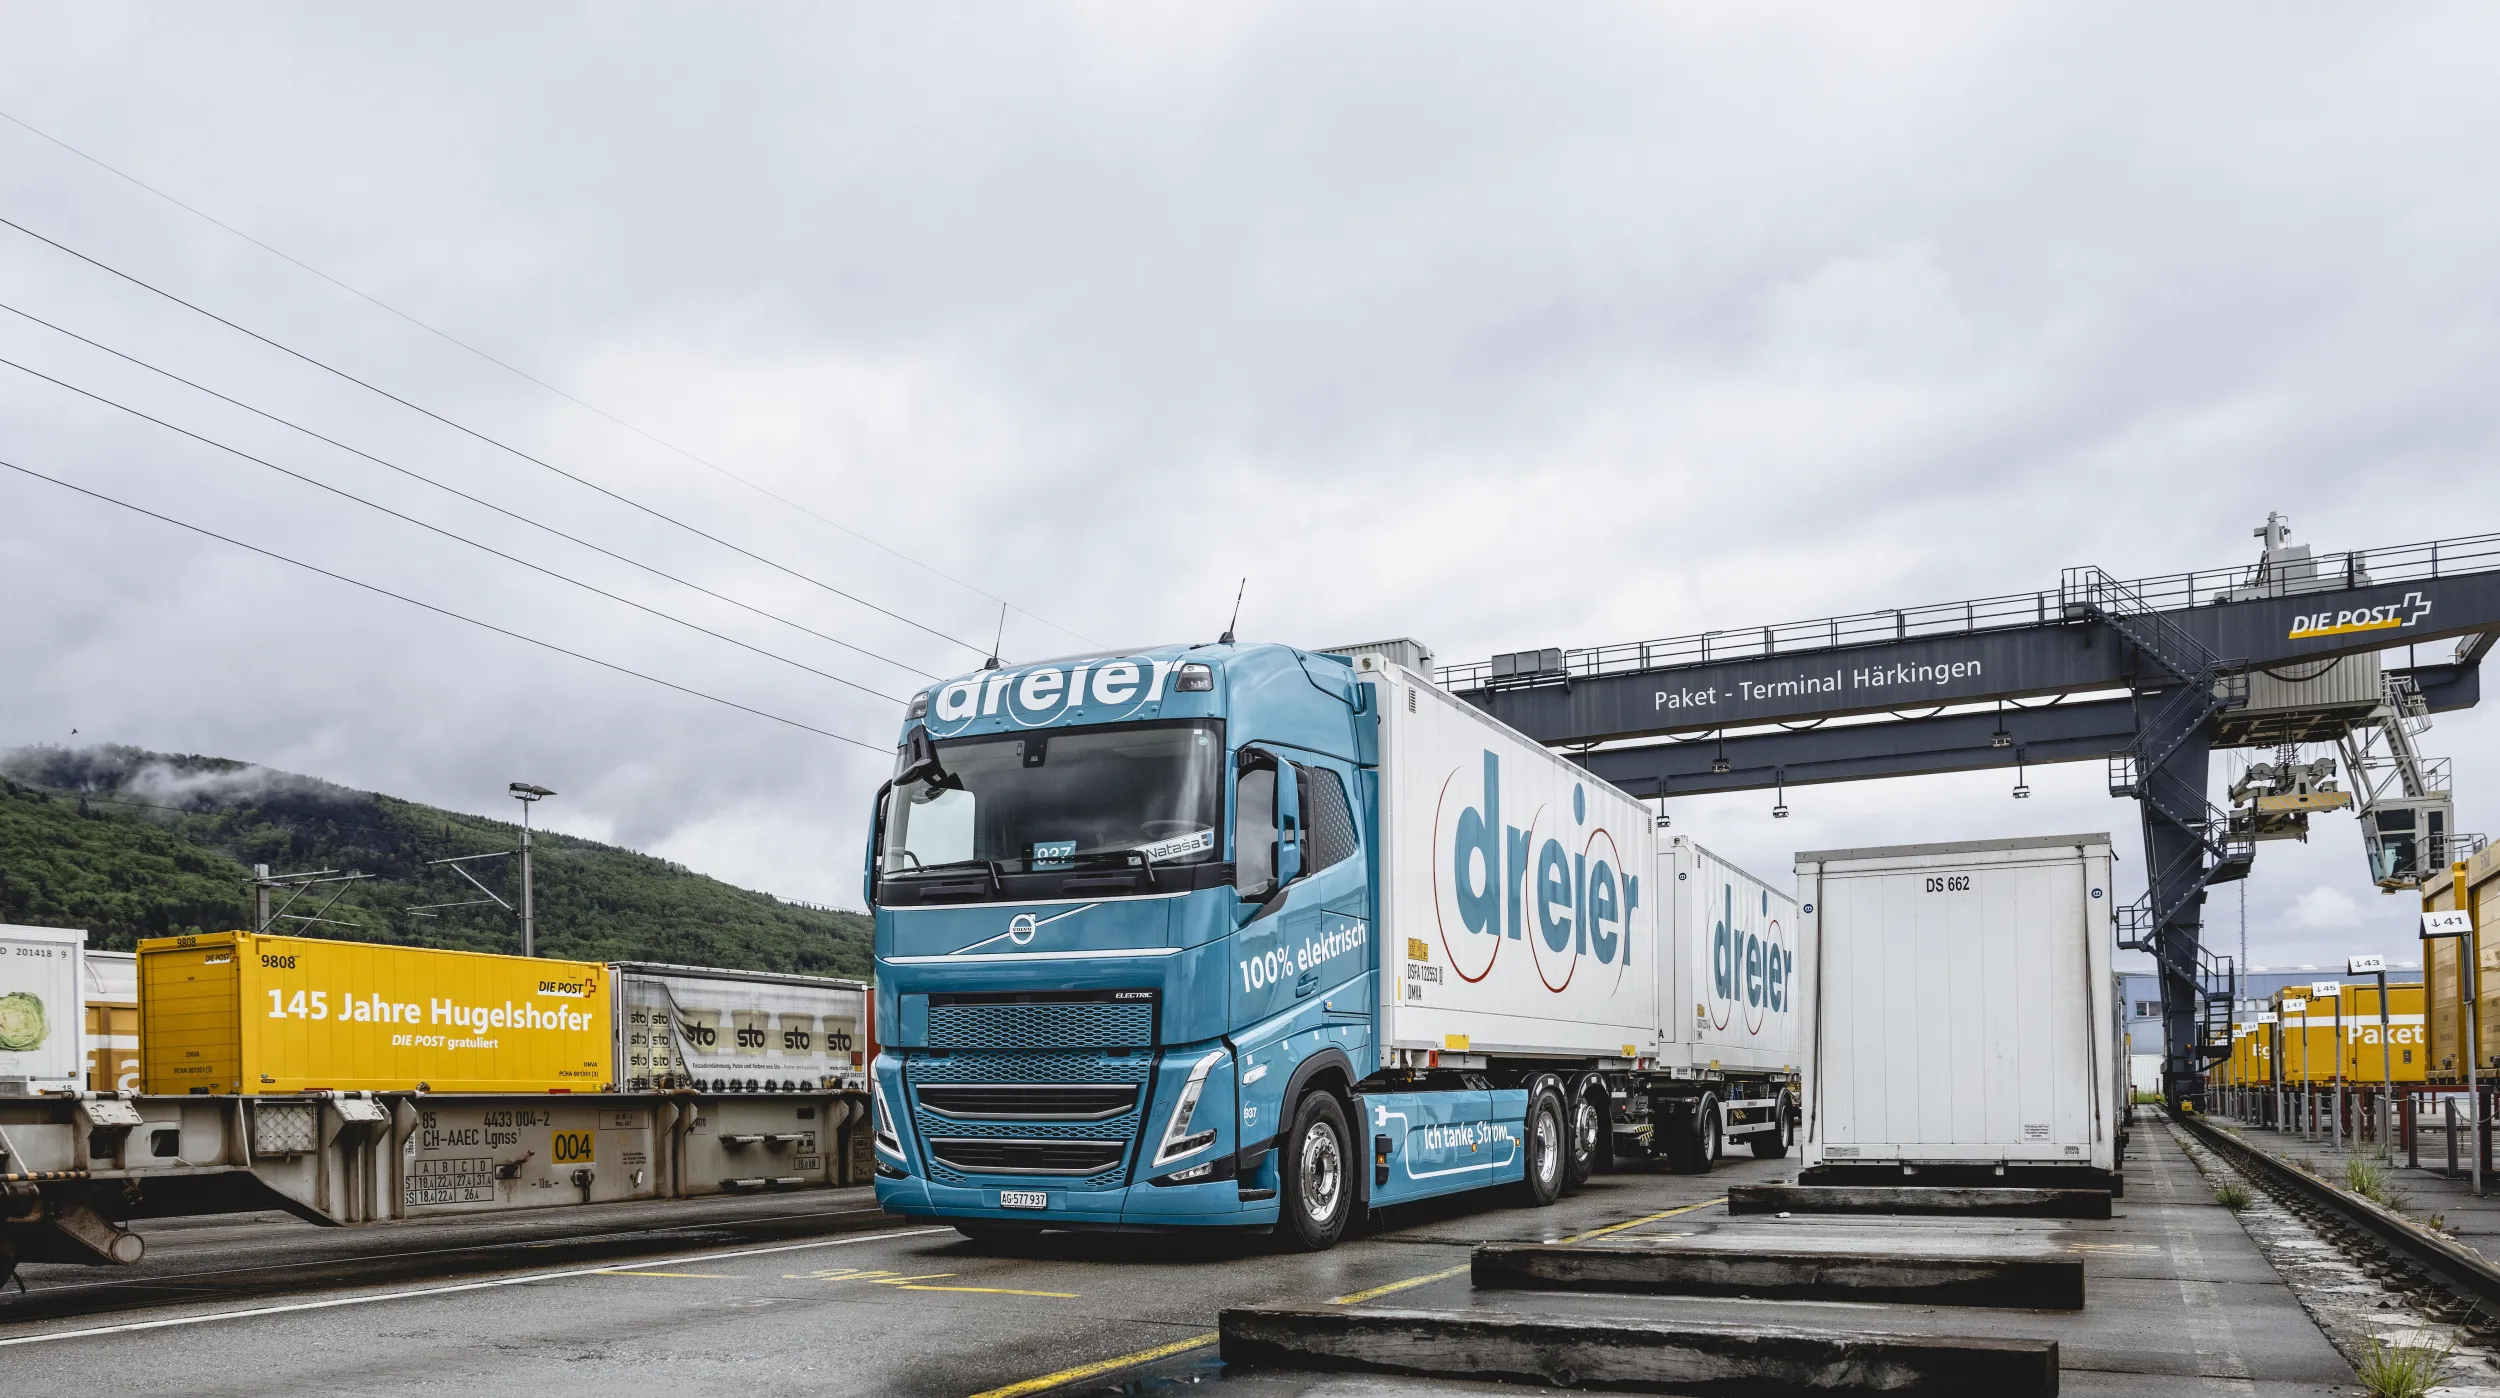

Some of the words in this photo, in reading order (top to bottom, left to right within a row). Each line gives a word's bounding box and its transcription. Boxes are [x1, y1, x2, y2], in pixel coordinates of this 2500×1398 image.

[2292, 612, 2332, 633] DIE
[2336, 604, 2401, 628] POST
[936, 658, 1187, 721] dreier
[1655, 688, 1716, 710] Paket
[1740, 670, 1842, 700] Terminal
[1853, 660, 1982, 688] Härkingen
[1146, 838, 1201, 859] Nataša
[1454, 748, 1639, 966] dreier
[1926, 878, 1944, 893] DS
[1948, 876, 1970, 892] 662
[2444, 917, 2463, 926] 41
[177, 937, 197, 948] 9808
[1714, 883, 1792, 1013] dreier
[16, 947, 52, 958] 201418
[61, 950, 67, 959] 9
[206, 954, 215, 962] DIE
[216, 953, 230, 961] POST
[261, 954, 296, 969] 9808
[1240, 945, 1294, 993] 100%
[1297, 916, 1366, 971] elektrisch
[1407, 963, 1420, 981] DSFA
[539, 981, 555, 992] DIE
[558, 982, 583, 994] POST
[268, 989, 328, 1020] 145
[338, 993, 421, 1024] Jahre
[431, 998, 593, 1034] Hugelshofer
[630, 1011, 647, 1024] sto
[652, 1012, 668, 1025] sto
[392, 1034, 412, 1046] DIE
[415, 1035, 446, 1047] POST
[448, 1037, 498, 1050] gratuliert
[630, 1032, 647, 1045] sto
[653, 1033, 669, 1046] sto
[737, 1023, 766, 1049] sto
[784, 1025, 811, 1050] sto
[828, 1028, 852, 1052] sto
[631, 1053, 647, 1066] sto
[653, 1054, 669, 1067] sto
[422, 1112, 437, 1129] 85
[484, 1111, 512, 1128] 4433
[516, 1110, 550, 1127] 004-2
[1244, 1107, 1257, 1119] 937
[423, 1129, 479, 1147] CH-AAEC
[1424, 1124, 1442, 1149] Ich
[1443, 1122, 1474, 1148] tanke
[1476, 1121, 1509, 1145] Strom
[555, 1134, 592, 1160] 004
[423, 1163, 429, 1174] A
[443, 1162, 448, 1173] B
[462, 1161, 467, 1172] C
[481, 1161, 486, 1172] D
